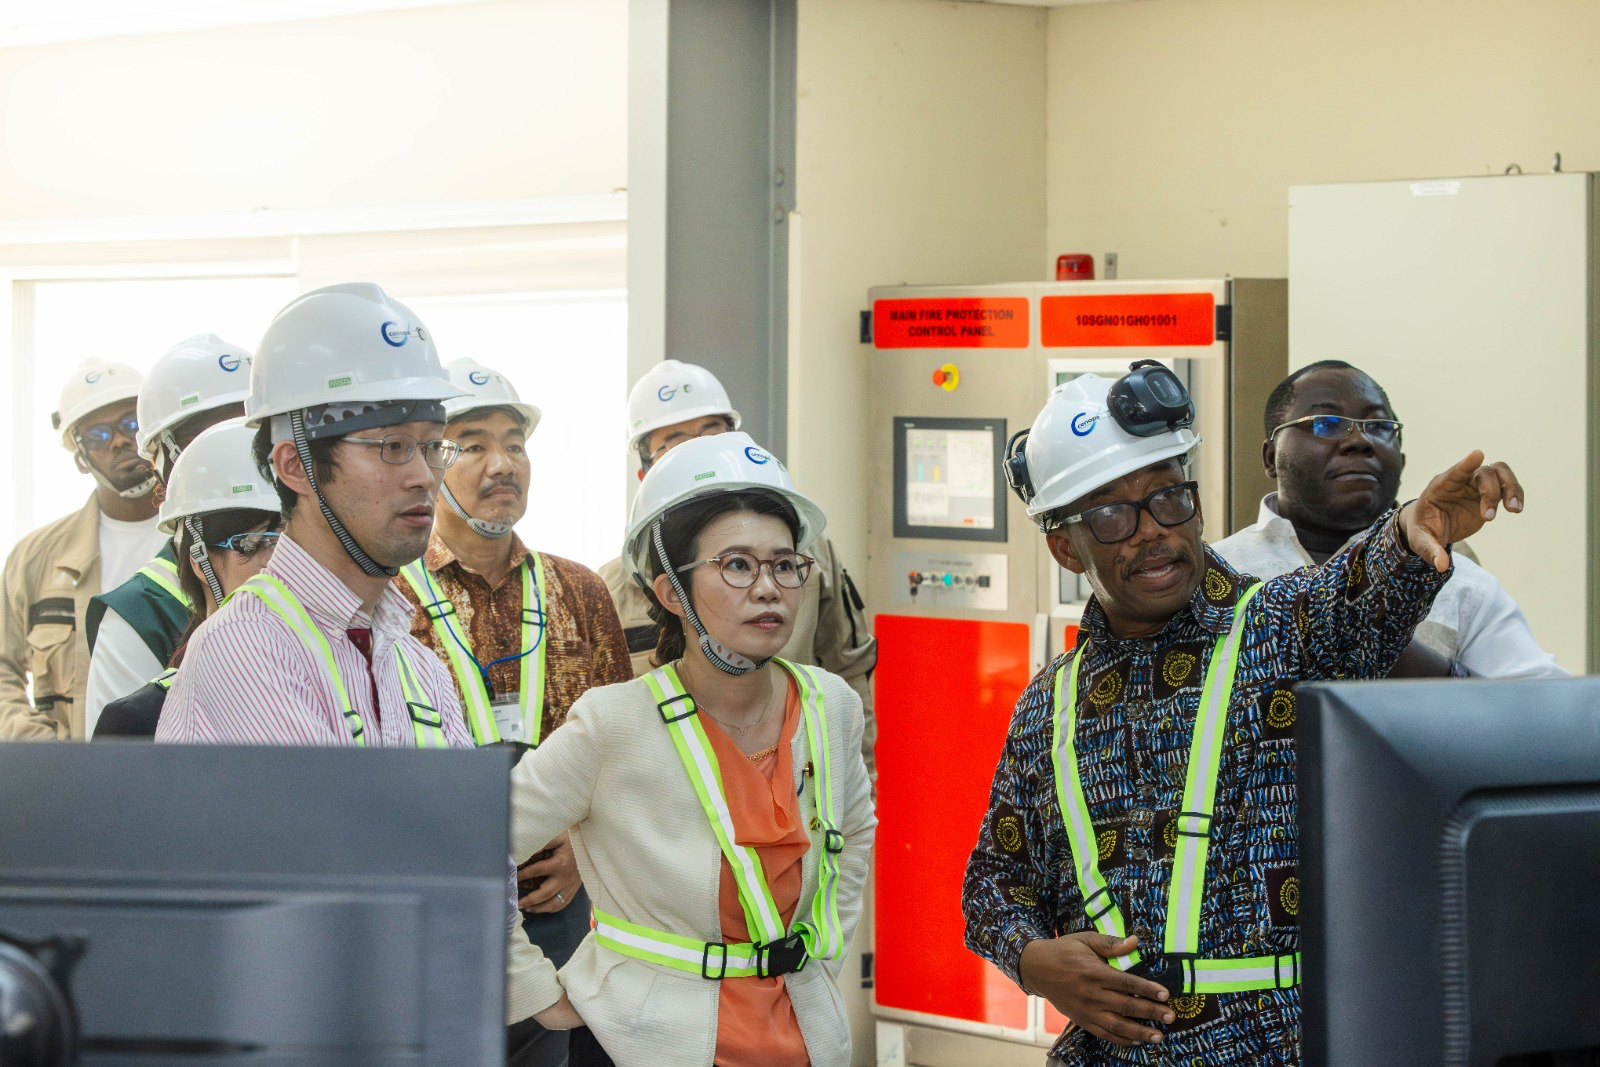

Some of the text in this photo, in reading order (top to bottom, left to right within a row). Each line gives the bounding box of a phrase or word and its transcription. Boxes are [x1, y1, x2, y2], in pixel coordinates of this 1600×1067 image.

[890, 309, 1014, 320] MAIN FIRE PROTECTION
[908, 326, 995, 337] CONTROL PANEL
